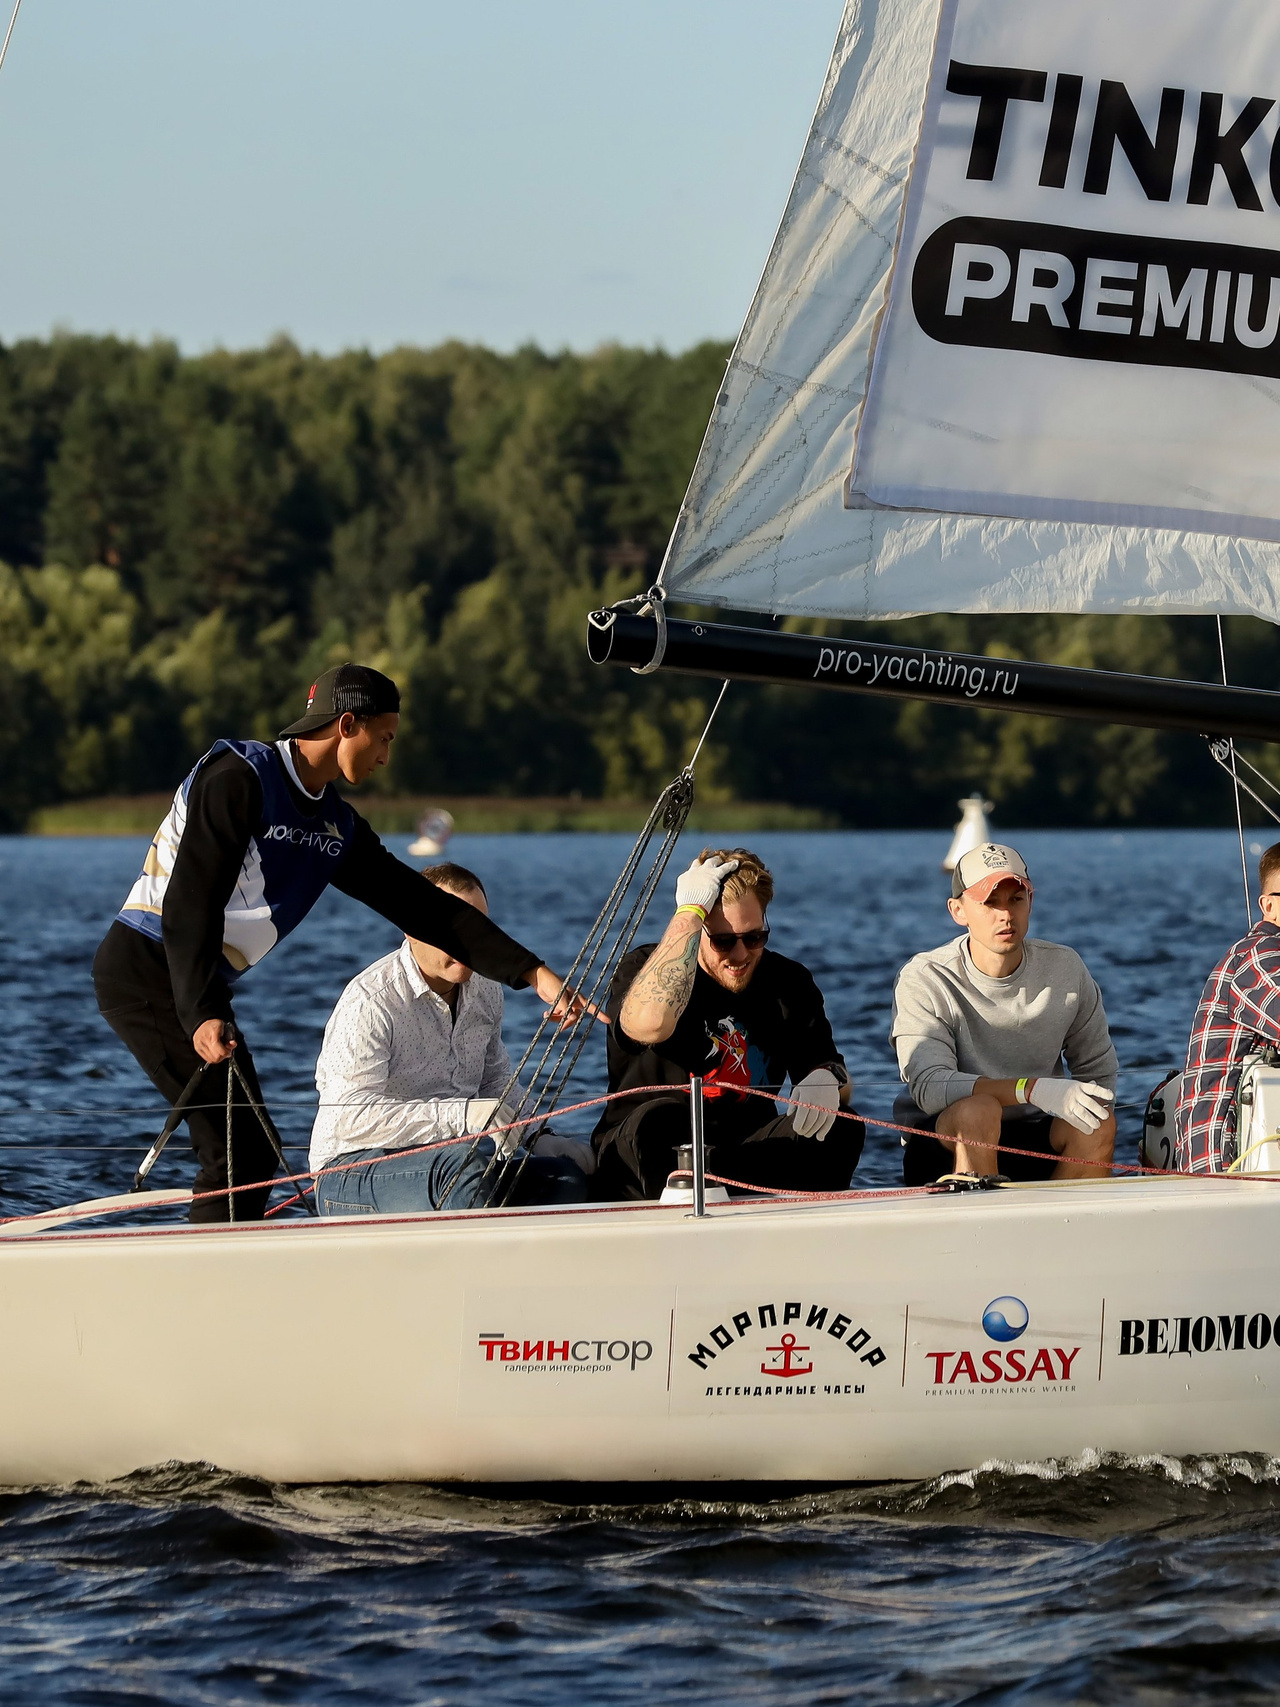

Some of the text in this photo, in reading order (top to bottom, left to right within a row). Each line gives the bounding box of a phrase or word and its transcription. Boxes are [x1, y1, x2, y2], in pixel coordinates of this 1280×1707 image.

[813, 647, 1019, 697] pro-yachting.ru
[687, 1302, 887, 1370] МОРПРИБОР
[504, 1364, 612, 1374] галерея интерьеров
[924, 1347, 1082, 1384] TASSAY
[705, 1384, 866, 1397] ЛЕГЕНДАРНЫЕ ЧАСЫ
[925, 1385, 1077, 1396] PREMIUM DRINKING WATER
